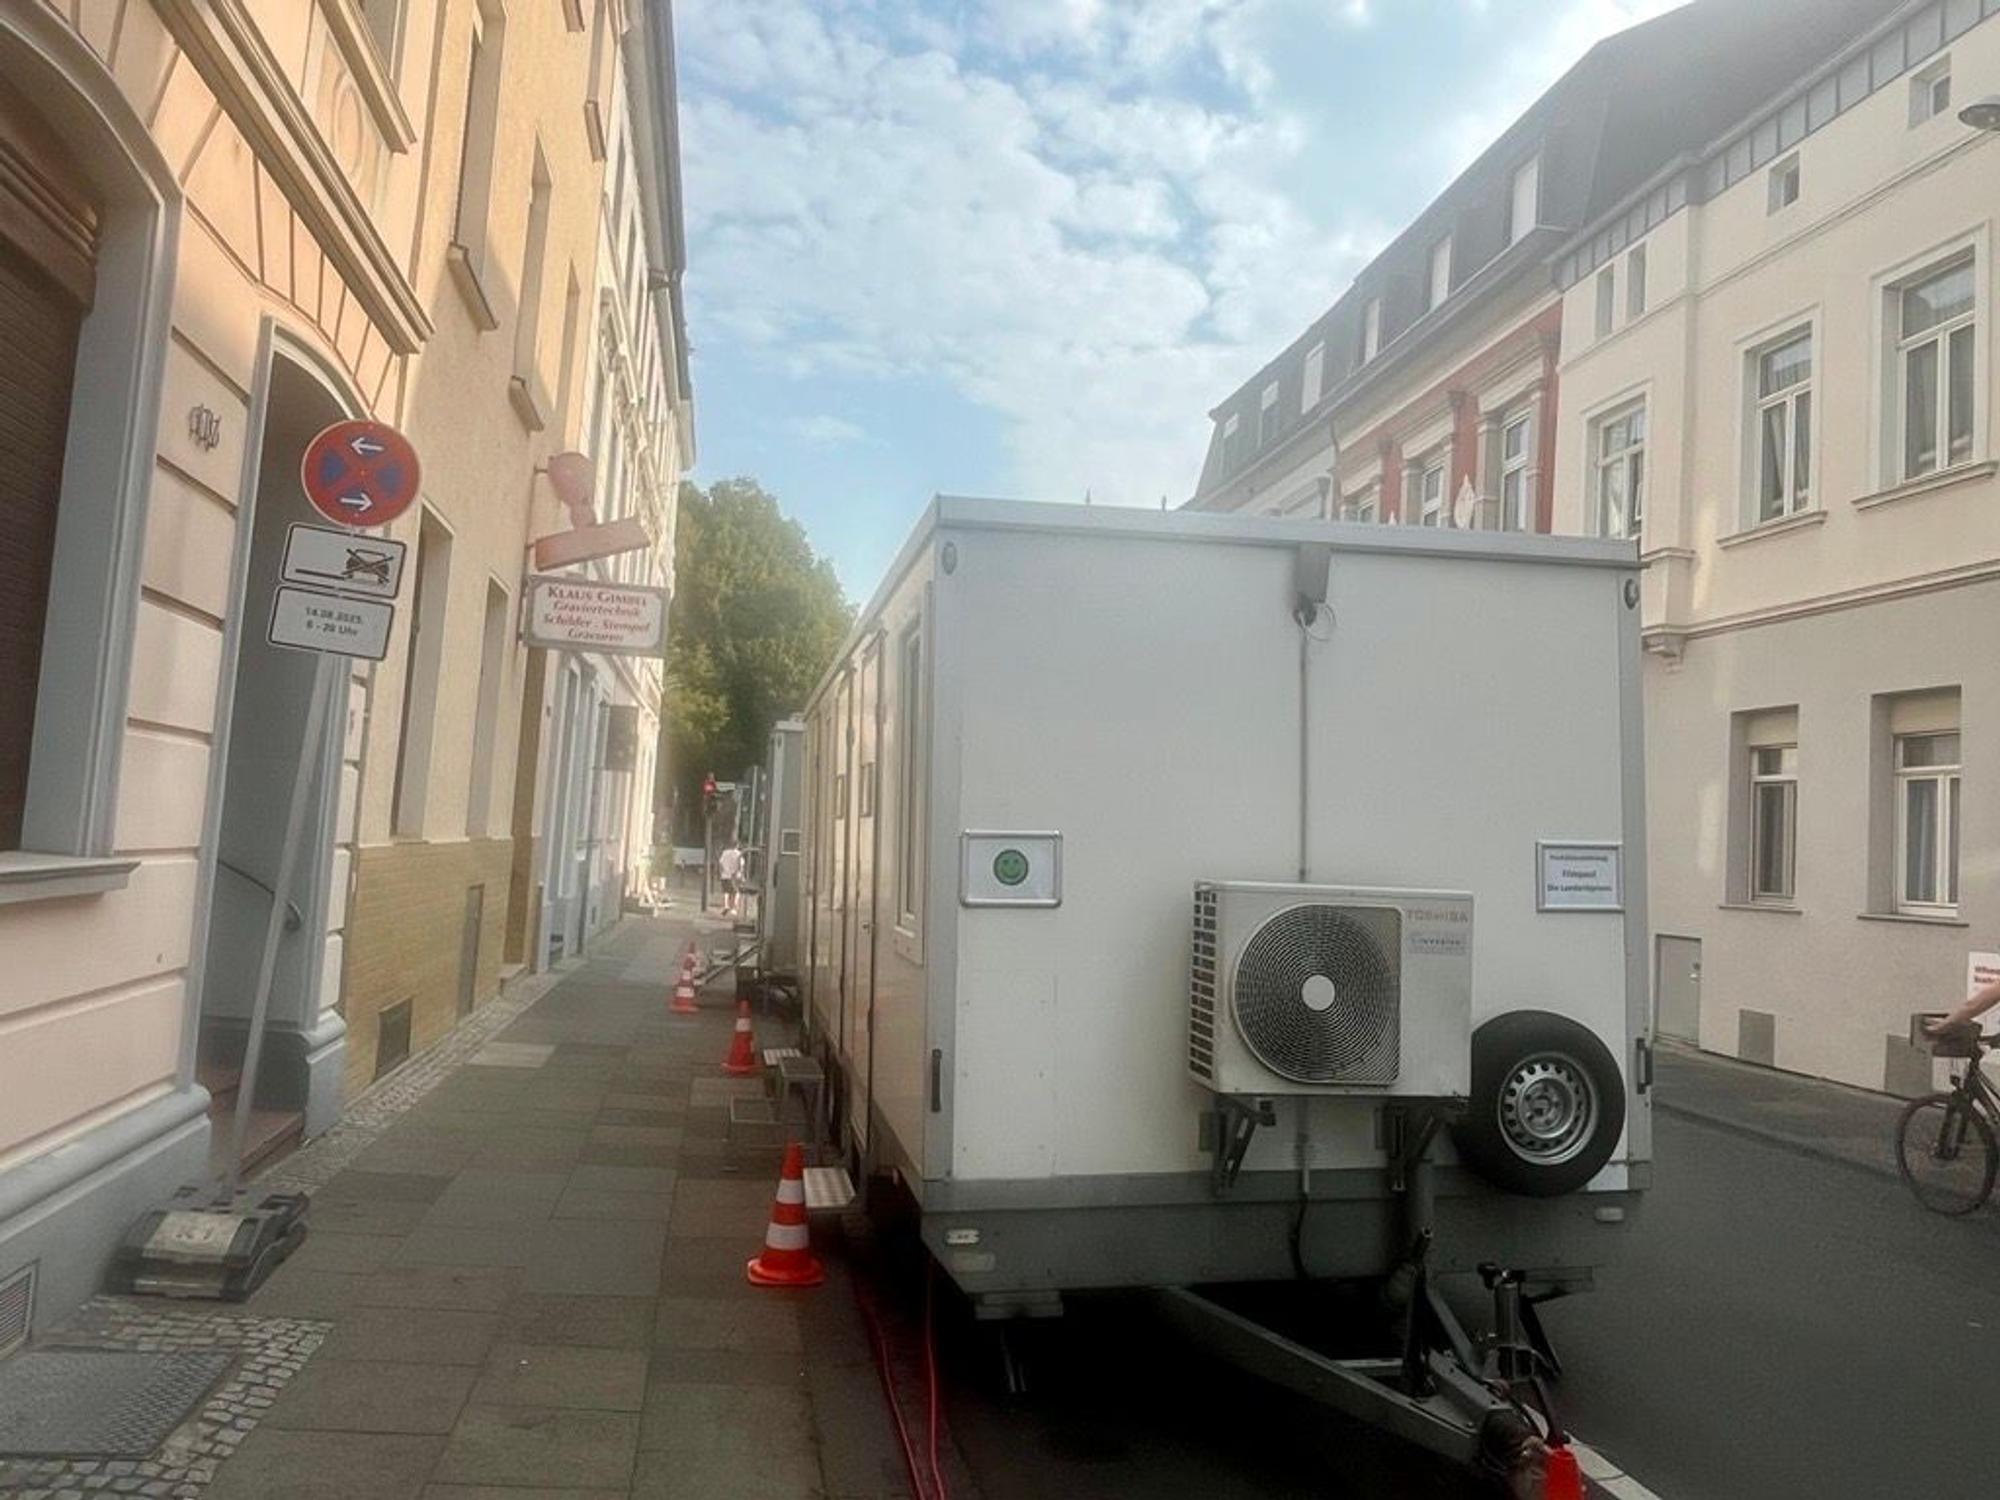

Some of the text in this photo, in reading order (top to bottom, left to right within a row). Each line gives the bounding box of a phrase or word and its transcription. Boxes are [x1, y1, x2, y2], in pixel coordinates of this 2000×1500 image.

[548, 586, 592, 601] KLAUS
[543, 613, 592, 628] Schilder
[602, 619, 651, 633] Stempel
[1407, 910, 1469, 923] TOSHIBA
